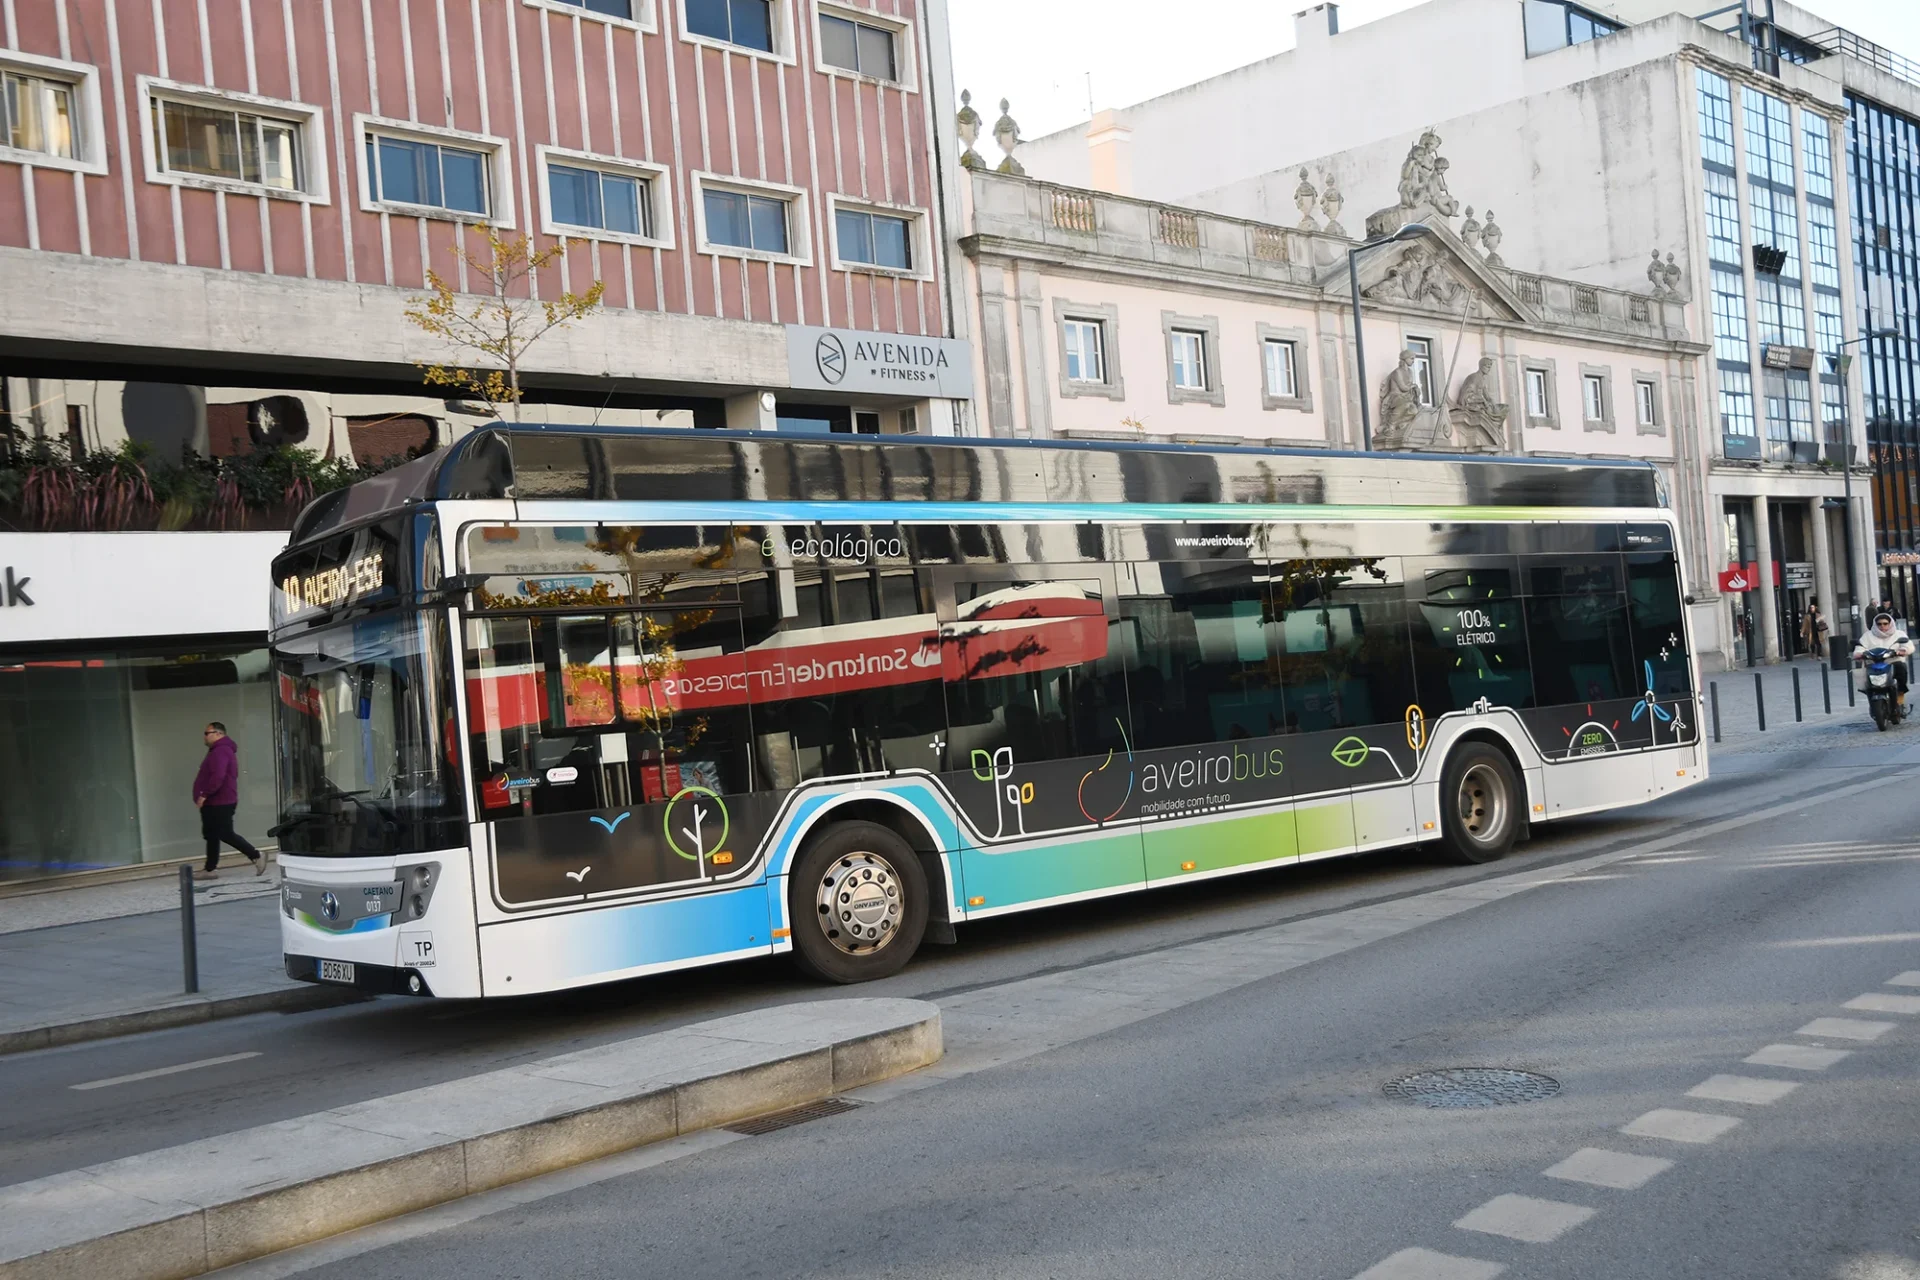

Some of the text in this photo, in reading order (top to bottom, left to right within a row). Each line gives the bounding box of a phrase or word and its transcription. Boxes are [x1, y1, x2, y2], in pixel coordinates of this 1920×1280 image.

[854, 341, 949, 367] AVENIDA
[881, 368, 926, 381] FITNESS
[761, 532, 901, 565] é ecológico
[1175, 534, 1255, 548] www.aveirobus.pt
[0, 566, 35, 607] k
[283, 575, 300, 615] 10
[1457, 609, 1491, 628] 100%
[1456, 631, 1496, 646] ELÉTRICO
[1582, 732, 1602, 745] ZERO
[1142, 744, 1284, 793] aveirobus
[1141, 793, 1231, 813] mobilidade com futuro
[363, 886, 394, 896] CAETANO
[366, 900, 381, 912] 0137
[414, 941, 432, 957] TP
